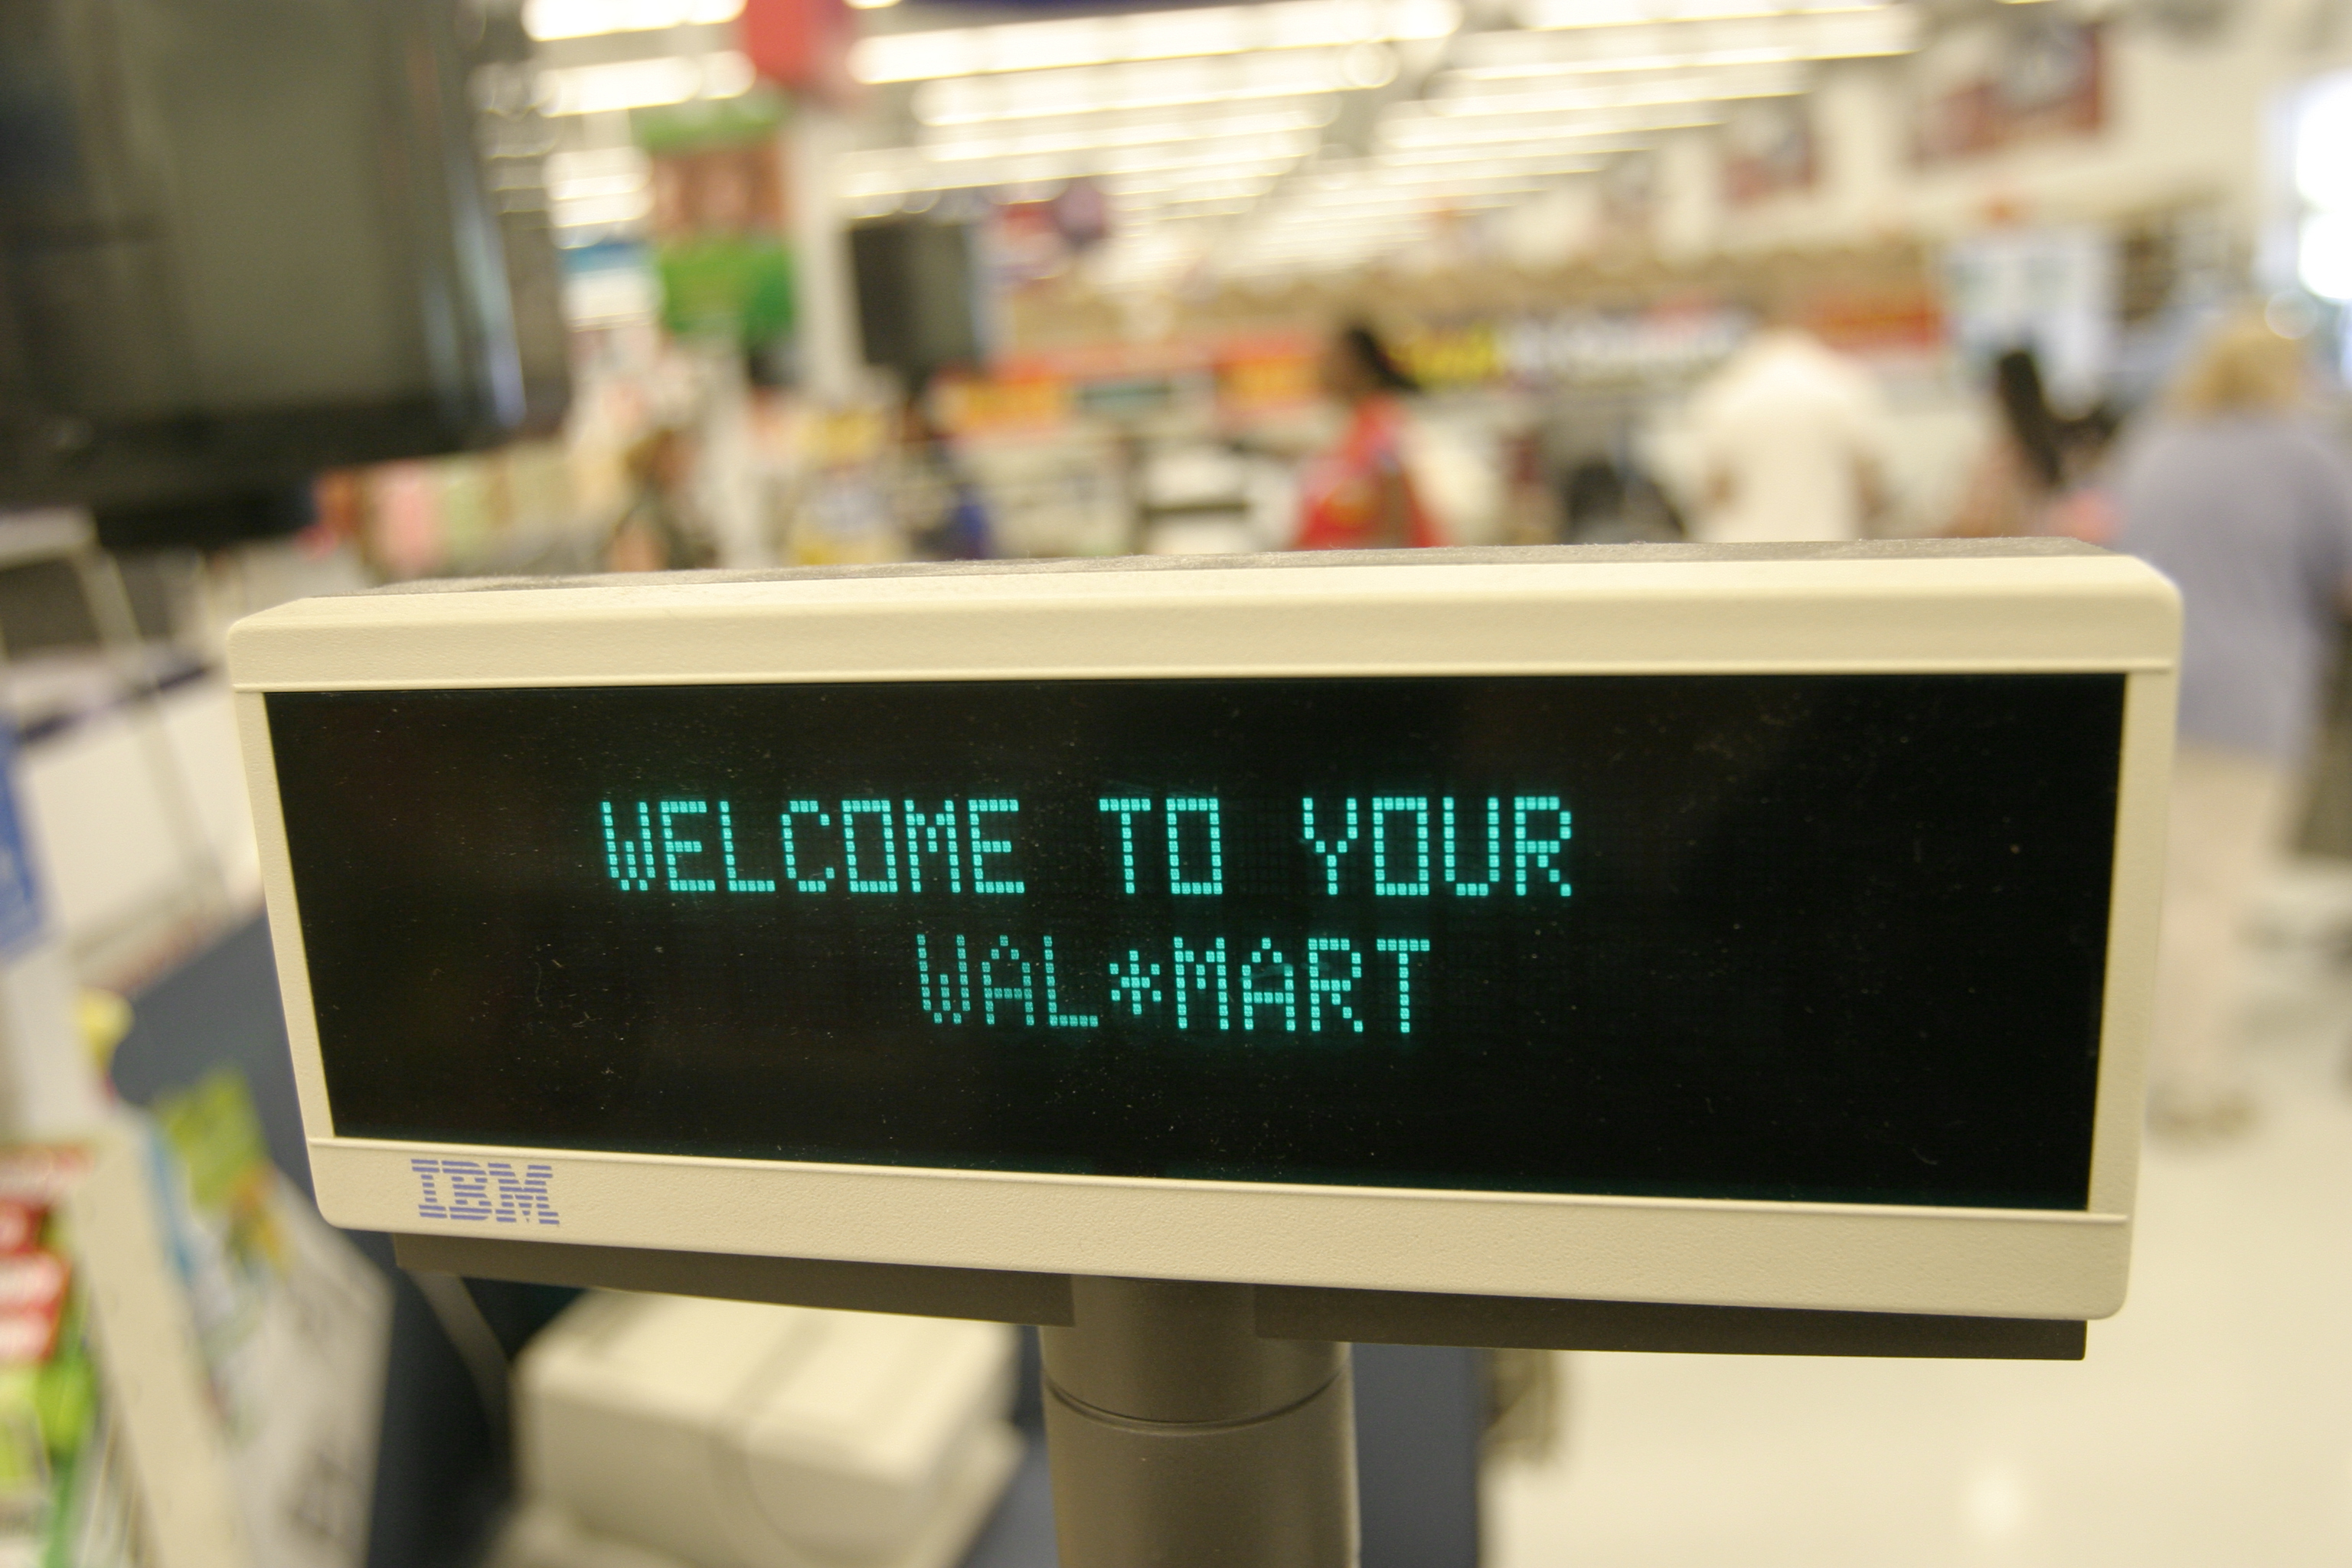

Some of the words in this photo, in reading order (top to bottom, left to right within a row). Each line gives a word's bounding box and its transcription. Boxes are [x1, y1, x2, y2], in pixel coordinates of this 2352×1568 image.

[601, 799, 1025, 893] WELCOME
[1099, 797, 1223, 895] TO
[1303, 795, 1572, 897] YOUR
[410, 1158, 560, 1226] IBM
